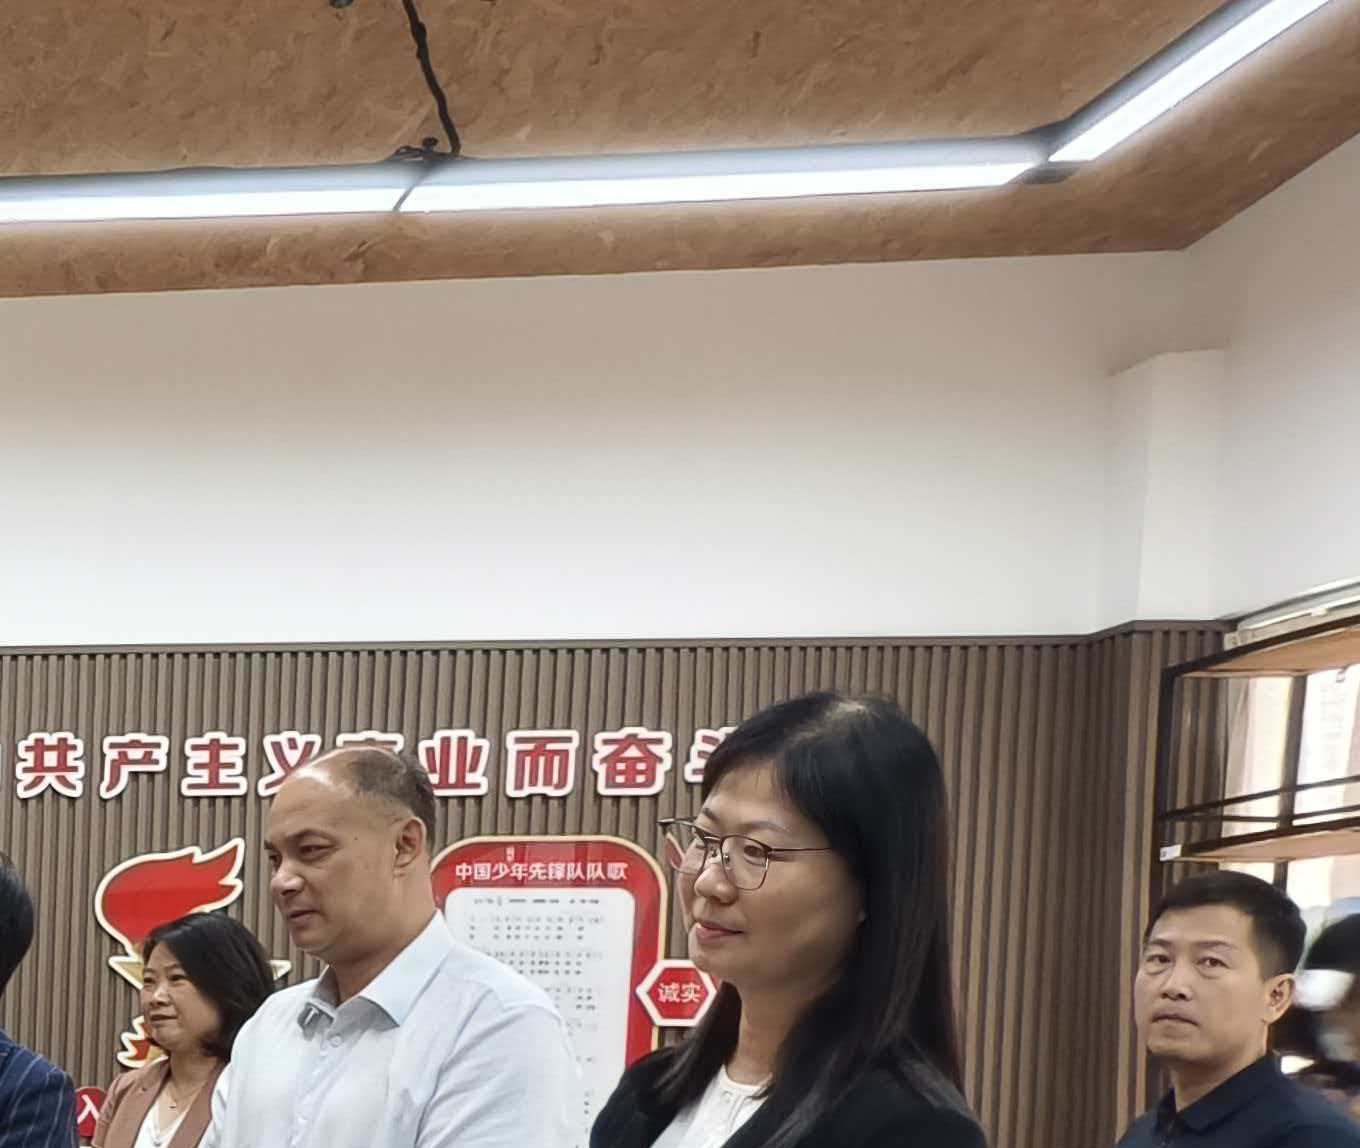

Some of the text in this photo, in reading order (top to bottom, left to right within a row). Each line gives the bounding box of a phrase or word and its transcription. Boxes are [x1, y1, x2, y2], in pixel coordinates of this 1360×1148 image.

[455, 862, 628, 880] 中国少年先锋队队歌
[658, 982, 701, 1003] 诚实
